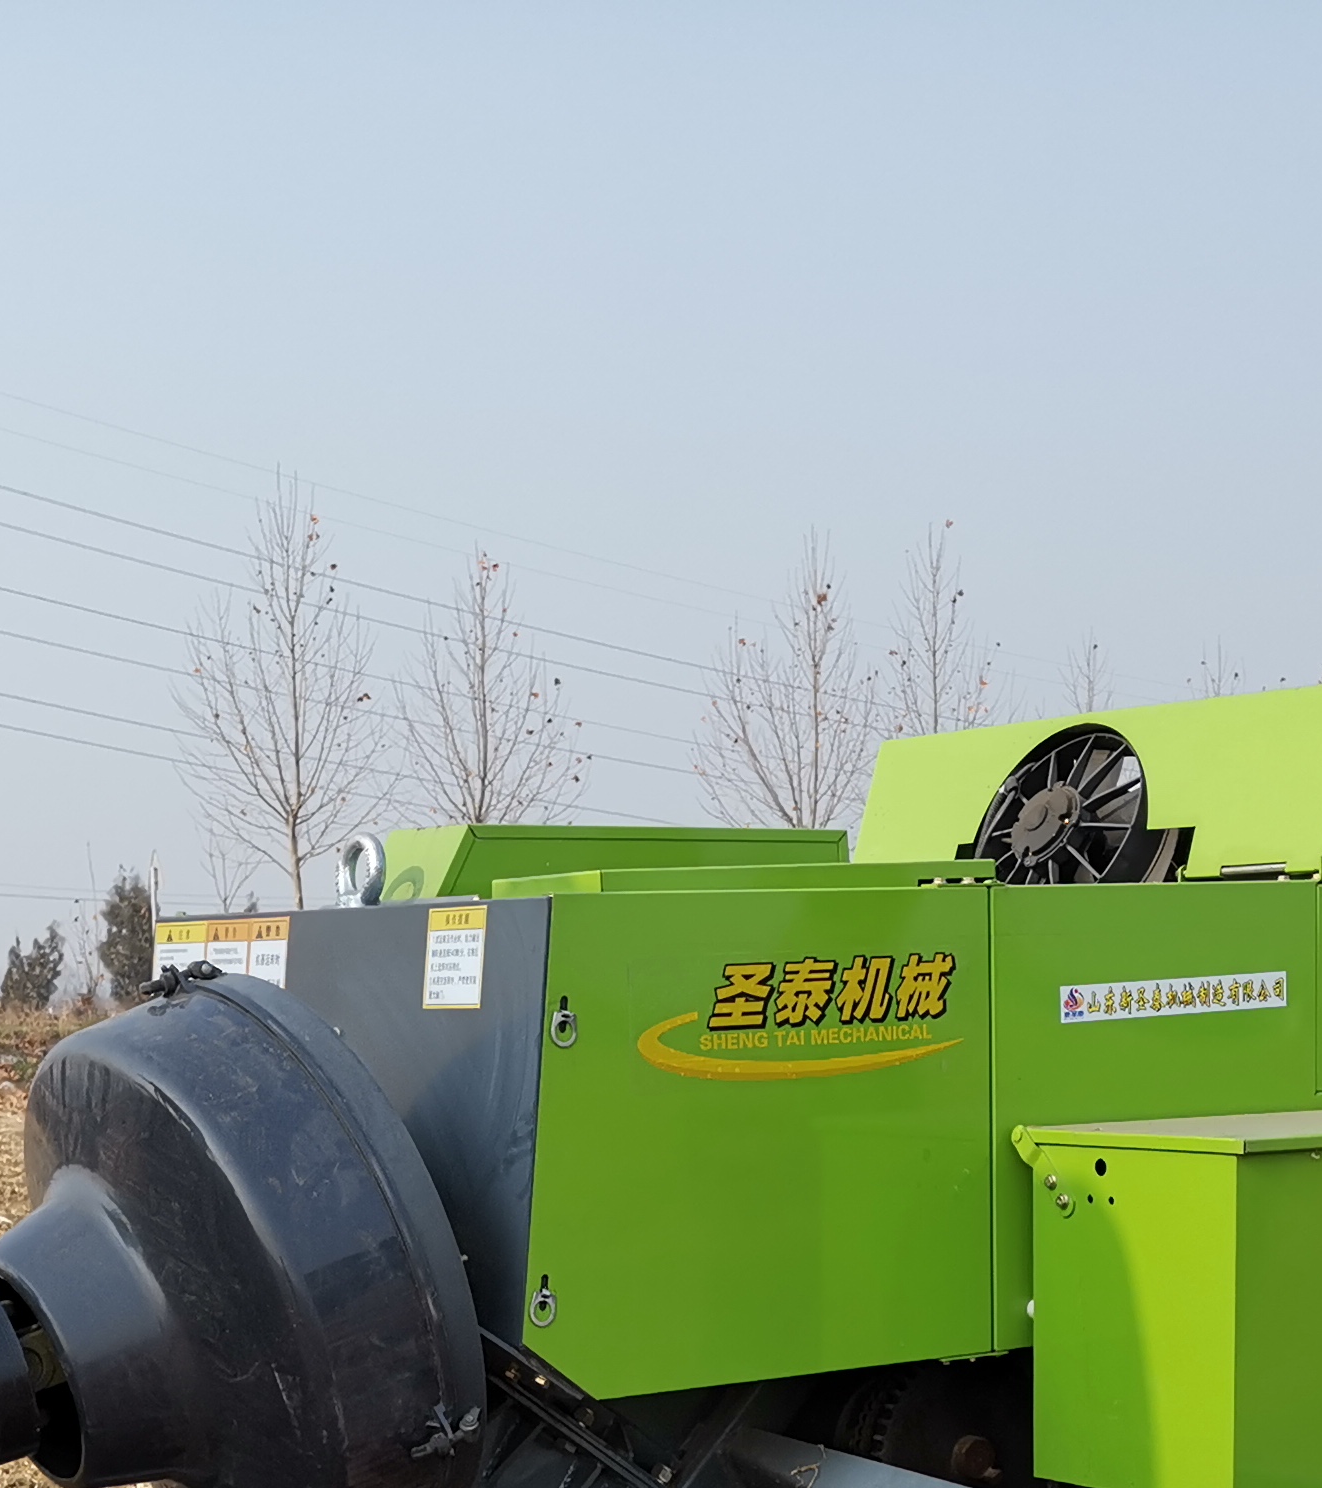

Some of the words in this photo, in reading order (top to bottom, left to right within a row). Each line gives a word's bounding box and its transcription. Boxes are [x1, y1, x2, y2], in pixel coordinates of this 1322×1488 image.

[707, 952, 955, 1031] 圣泰机械
[1086, 977, 1285, 1015] 山东新圣泰机械制造有限公司
[699, 1031, 769, 1051] SHENG
[773, 1030, 805, 1047] TAI
[810, 1024, 933, 1046] MECHANICAL
